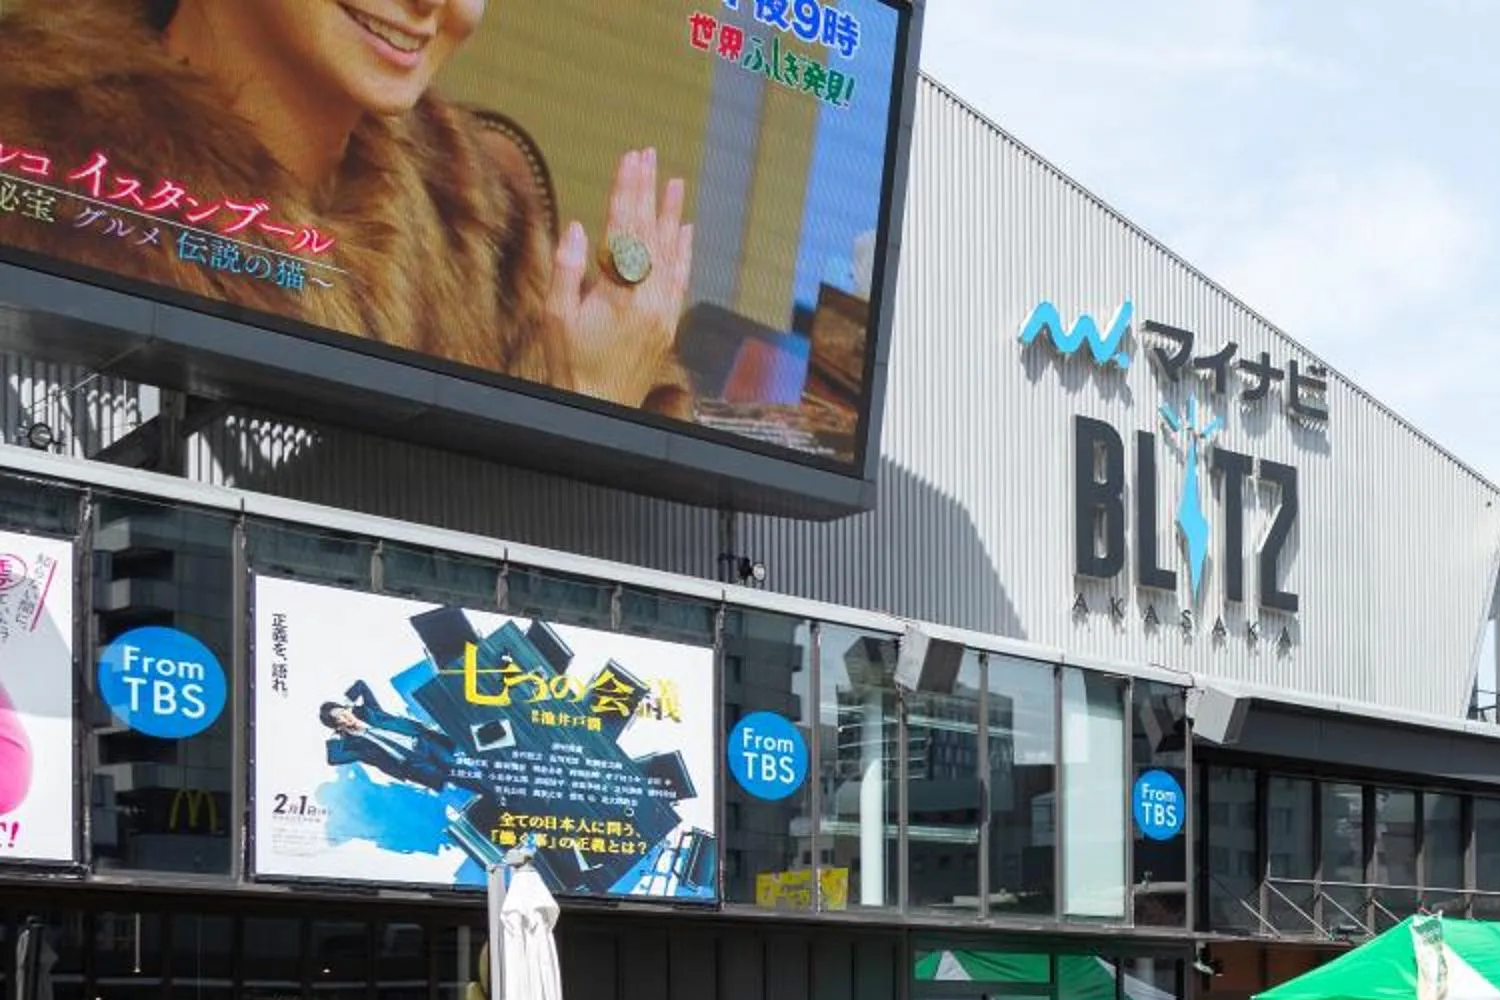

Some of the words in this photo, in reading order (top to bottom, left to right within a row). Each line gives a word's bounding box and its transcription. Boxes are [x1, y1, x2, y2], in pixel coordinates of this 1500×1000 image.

[690, 14, 854, 107] 世界ふしぎ発見!
[69, 152, 337, 254] イスタンブール
[74, 207, 161, 247] グルメ
[1142, 319, 1329, 422] マイナビ
[1075, 395, 1299, 613] BLITZ
[1072, 592, 1293, 648] AKASAKA
[123, 645, 204, 681] From
[122, 676, 206, 719] TBS
[743, 727, 794, 753] From
[743, 751, 795, 785] TBS
[1142, 783, 1177, 803] From
[1141, 801, 1177, 827] TBS
